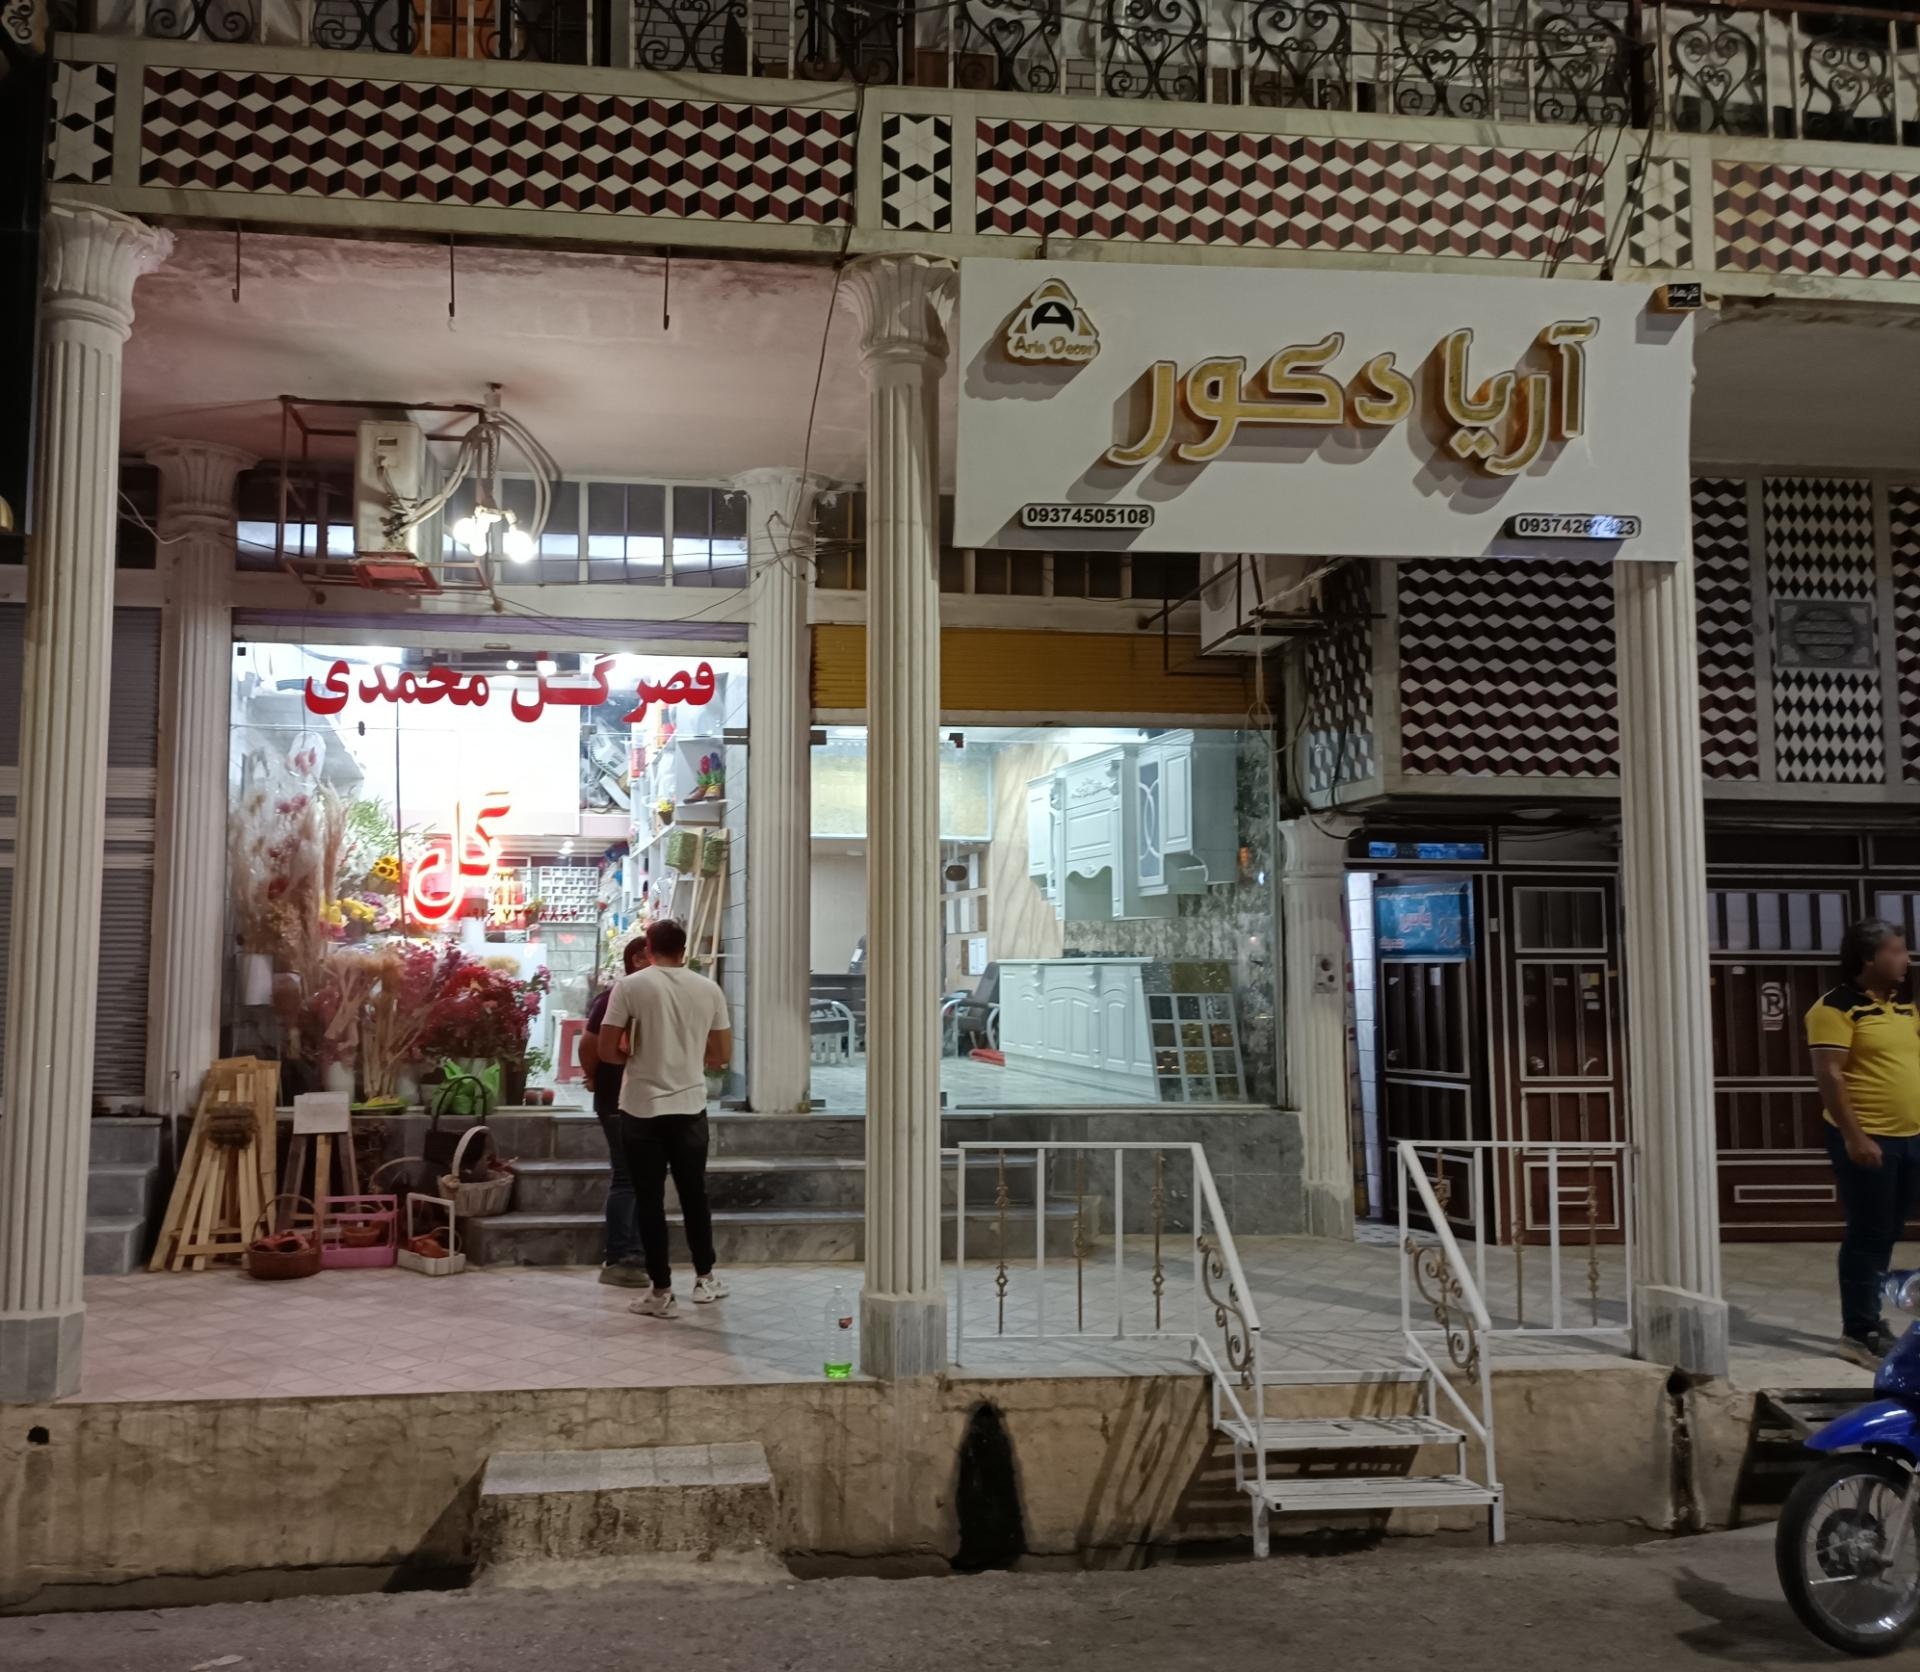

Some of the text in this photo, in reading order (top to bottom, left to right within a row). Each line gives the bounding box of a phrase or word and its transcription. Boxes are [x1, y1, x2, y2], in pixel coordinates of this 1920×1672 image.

[1014, 335, 1096, 356] Aria Decor
[1107, 317, 1600, 475] آریا دکور
[1027, 507, 1149, 524] 09374505108
[304, 660, 489, 715] محمدی
[408, 790, 512, 925] گل
